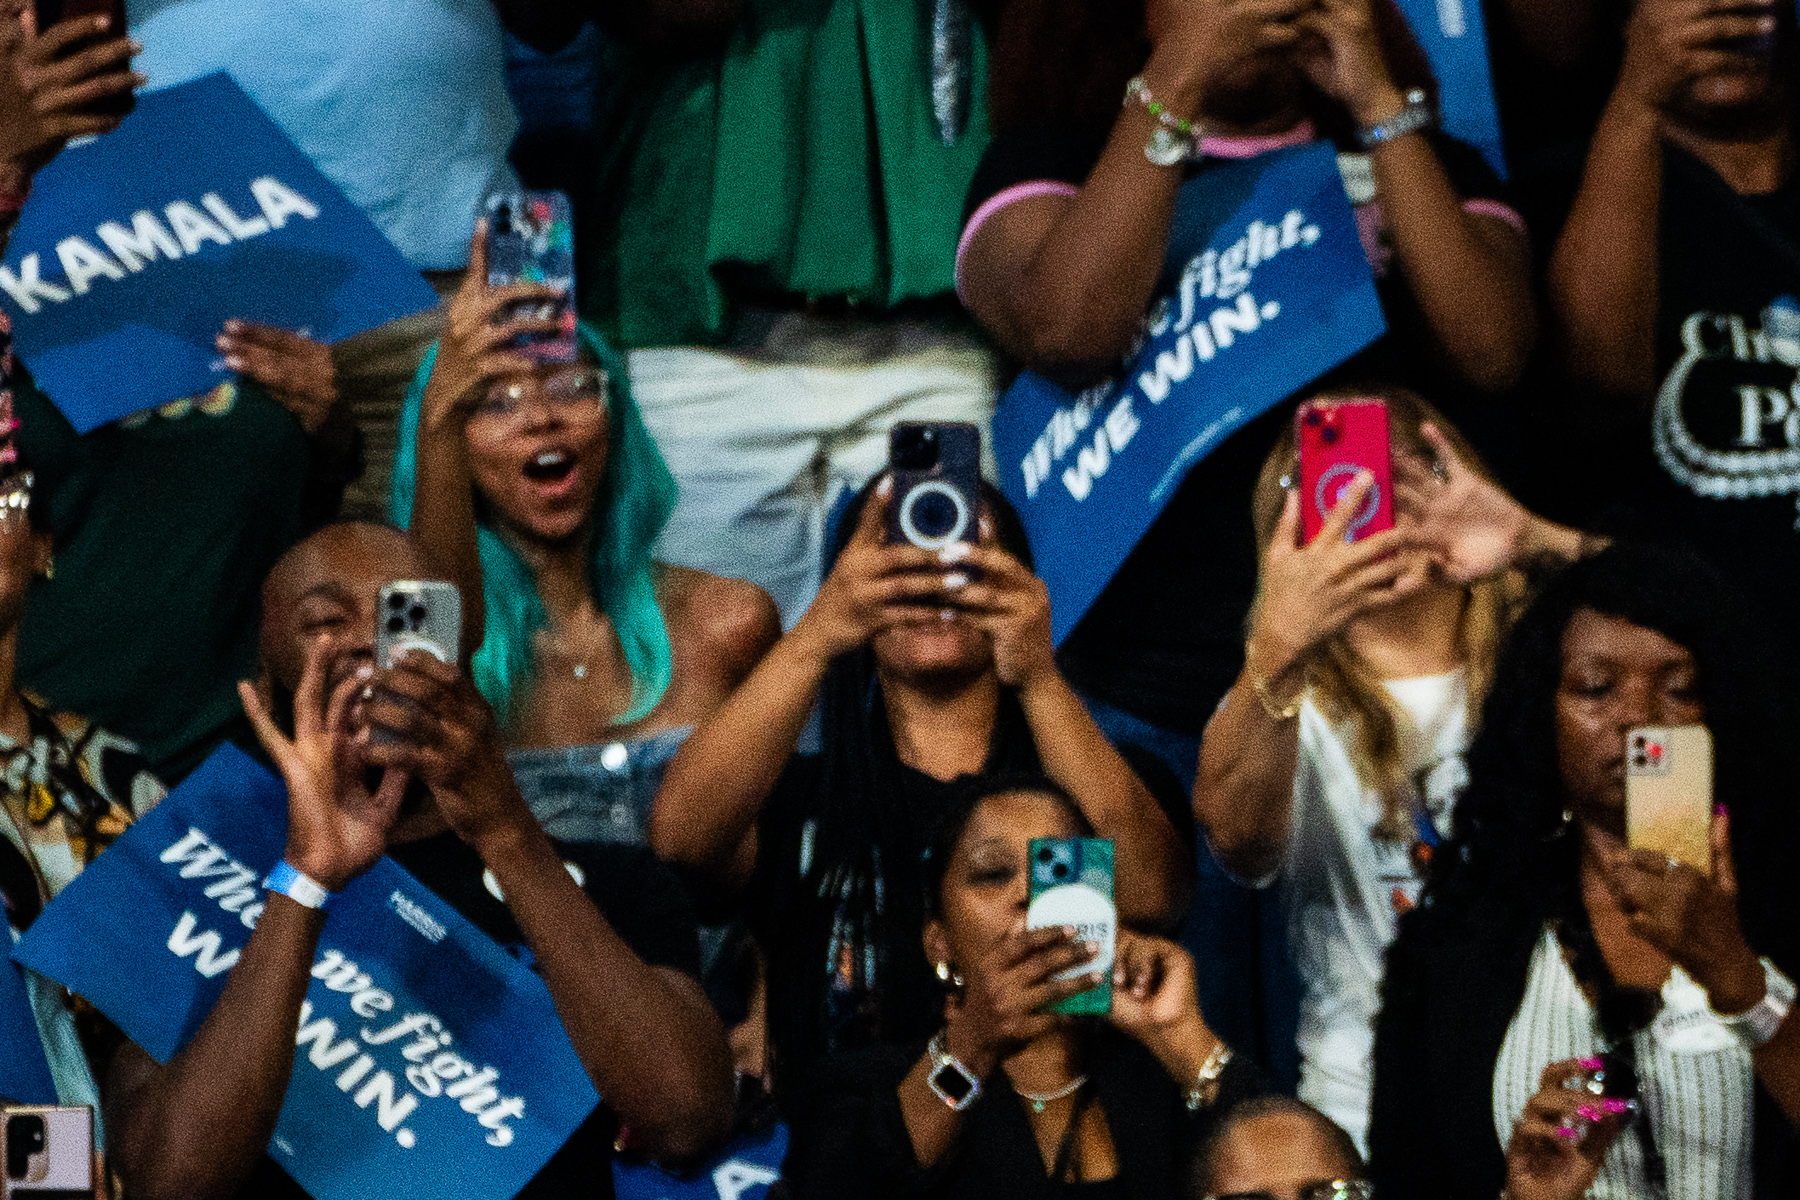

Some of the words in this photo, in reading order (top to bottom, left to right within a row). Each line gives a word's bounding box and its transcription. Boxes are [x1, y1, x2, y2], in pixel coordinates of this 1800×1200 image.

[0, 175, 320, 314] KAMALA
[1062, 394, 1141, 501] WE
[1138, 291, 1281, 404] WIN.
[159, 826, 266, 931] Whe
[310, 948, 394, 1019] we
[360, 1011, 526, 1148] fight,
[167, 909, 242, 979] W
[295, 999, 418, 1150] WIN.
